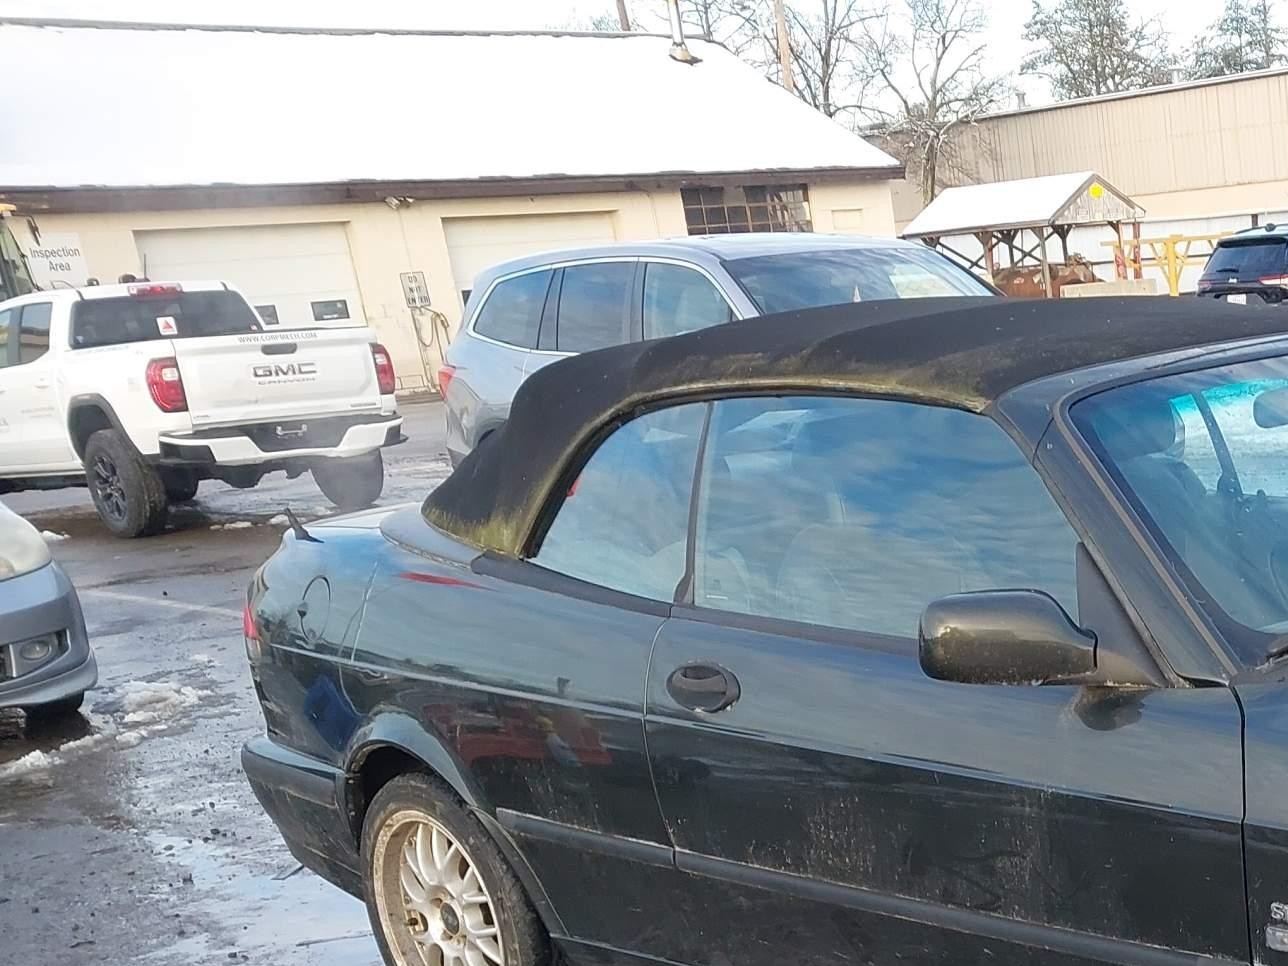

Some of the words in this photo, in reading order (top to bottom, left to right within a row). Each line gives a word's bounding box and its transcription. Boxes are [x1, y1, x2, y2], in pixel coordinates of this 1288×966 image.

[29, 247, 81, 260] Inspection
[49, 260, 71, 272] Area
[253, 362, 317, 378] GMC
